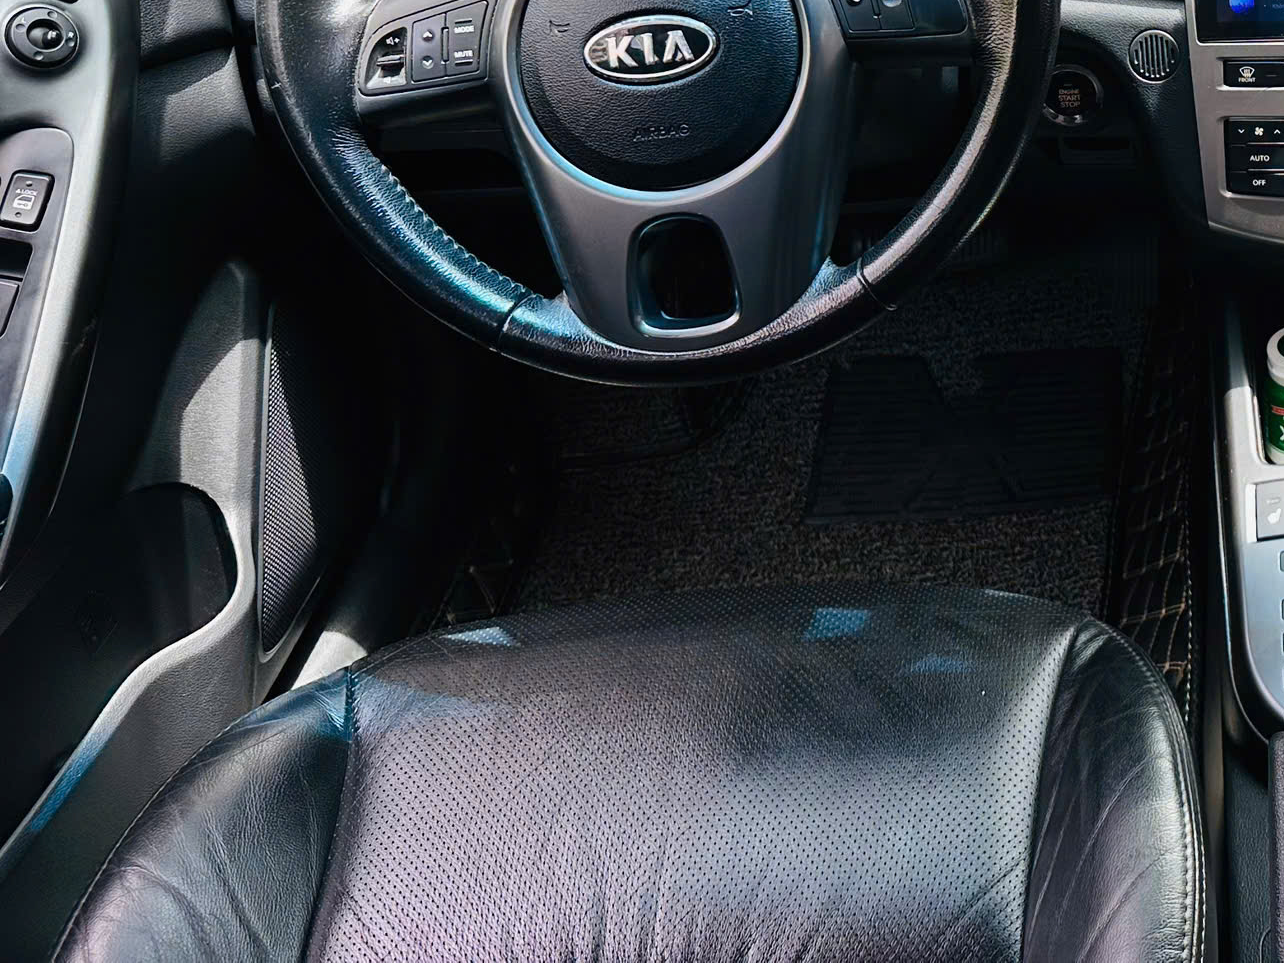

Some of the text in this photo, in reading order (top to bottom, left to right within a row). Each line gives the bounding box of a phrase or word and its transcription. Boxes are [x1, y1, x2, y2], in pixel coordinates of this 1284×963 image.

[453, 25, 475, 34] MODE
[605, 29, 695, 69] KIA
[453, 50, 473, 59] MUTE
